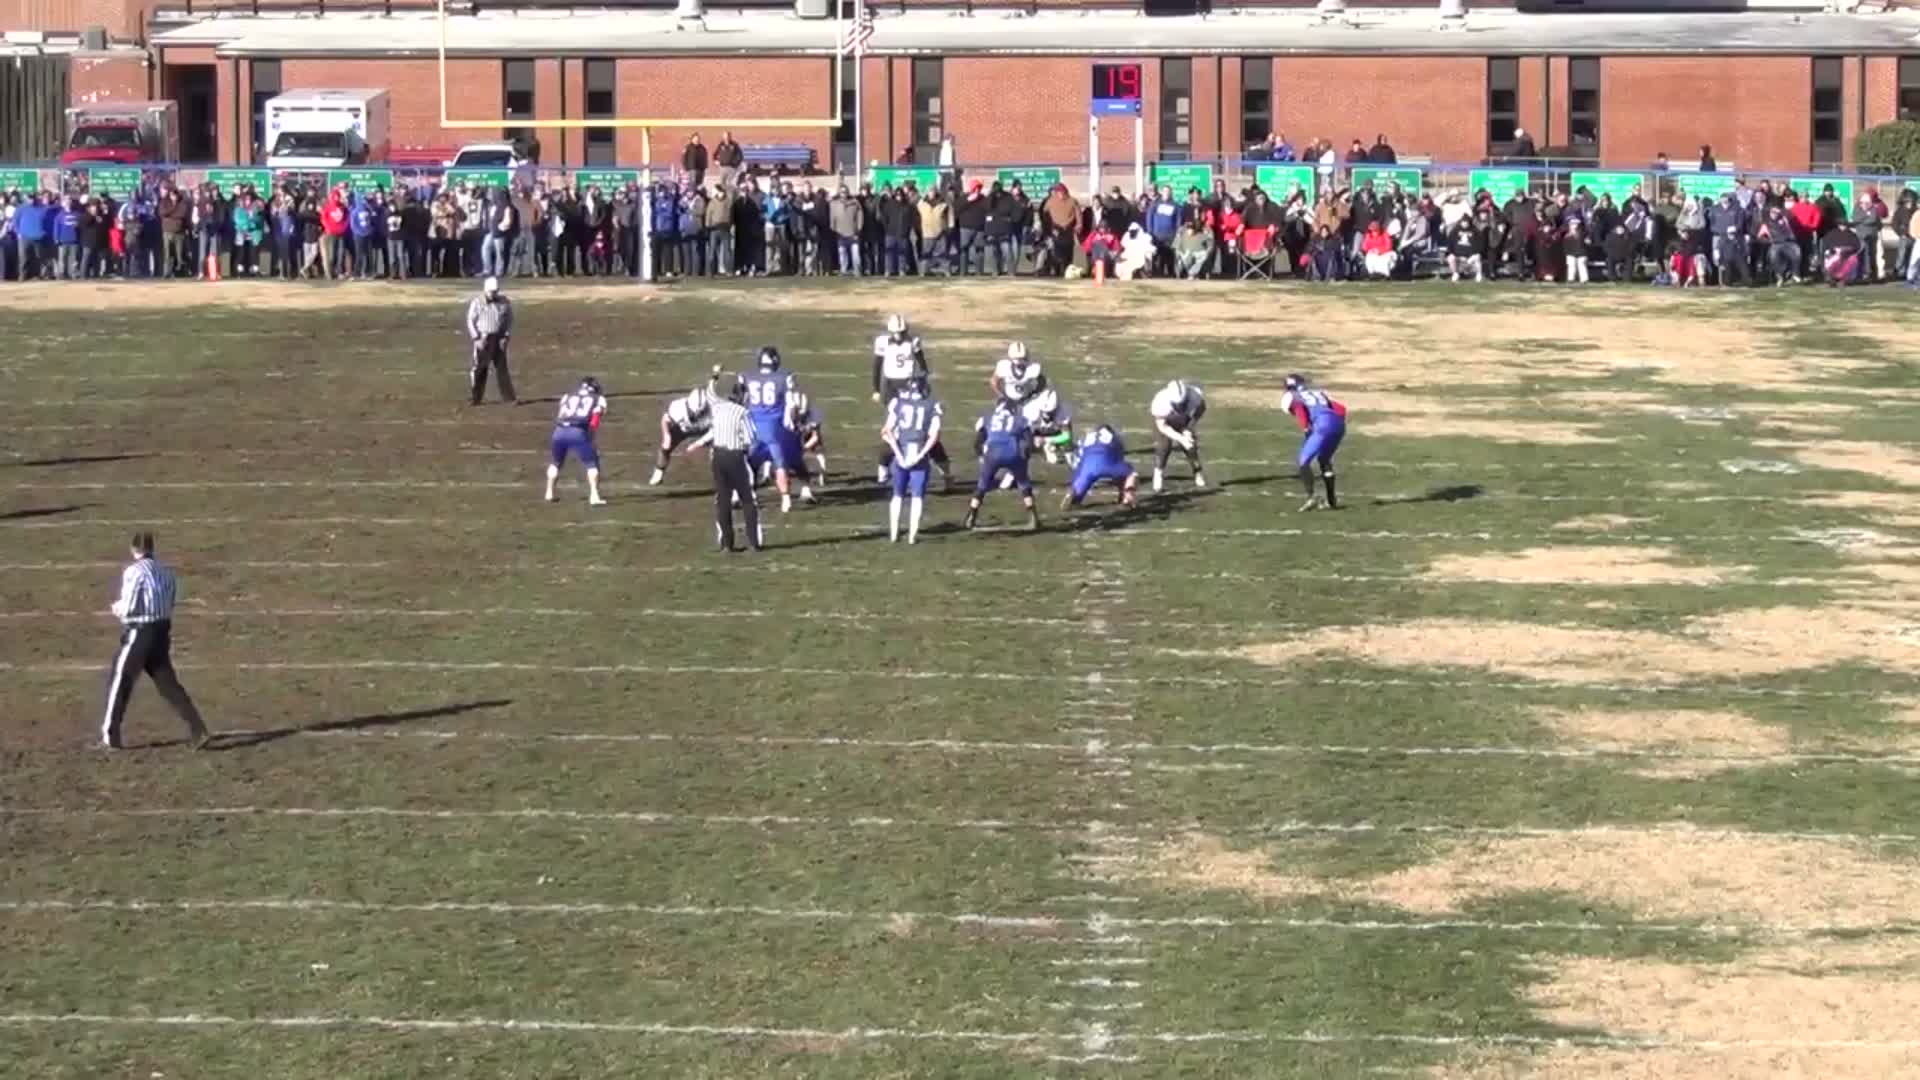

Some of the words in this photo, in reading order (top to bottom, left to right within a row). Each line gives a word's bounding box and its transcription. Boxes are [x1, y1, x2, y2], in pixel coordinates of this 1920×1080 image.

[1108, 66, 1139, 99] 19
[748, 380, 776, 405] 56
[899, 404, 925, 430] 31
